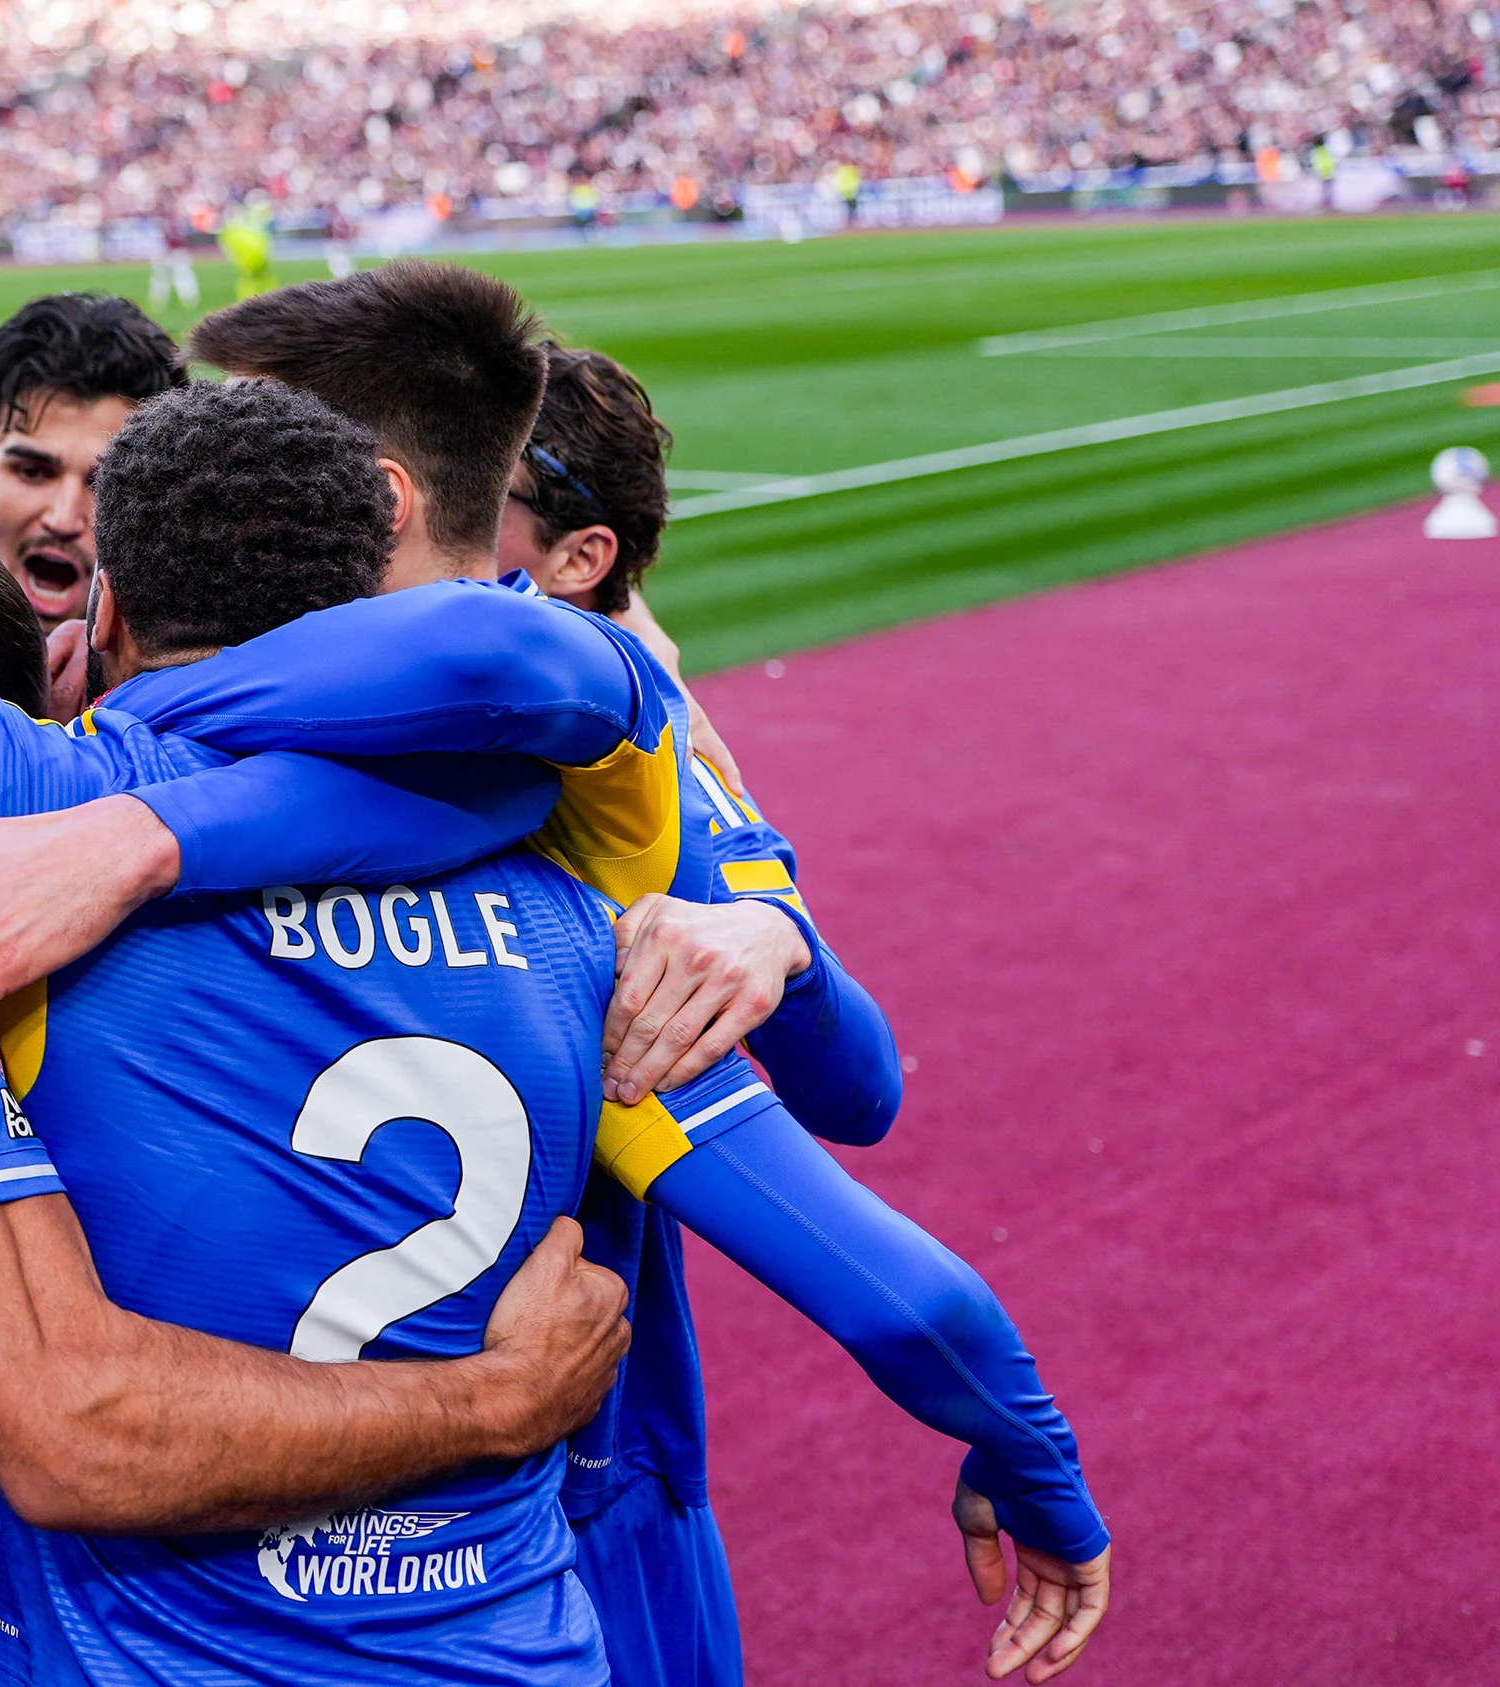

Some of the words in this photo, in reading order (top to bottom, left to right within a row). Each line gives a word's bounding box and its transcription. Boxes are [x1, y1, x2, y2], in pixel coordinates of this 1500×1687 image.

[262, 885, 529, 970] BOGLE
[289, 1034, 531, 1363] 2
[333, 1513, 418, 1535] WINGS
[328, 1535, 346, 1544] FOR
[344, 1536, 395, 1556] LIFE
